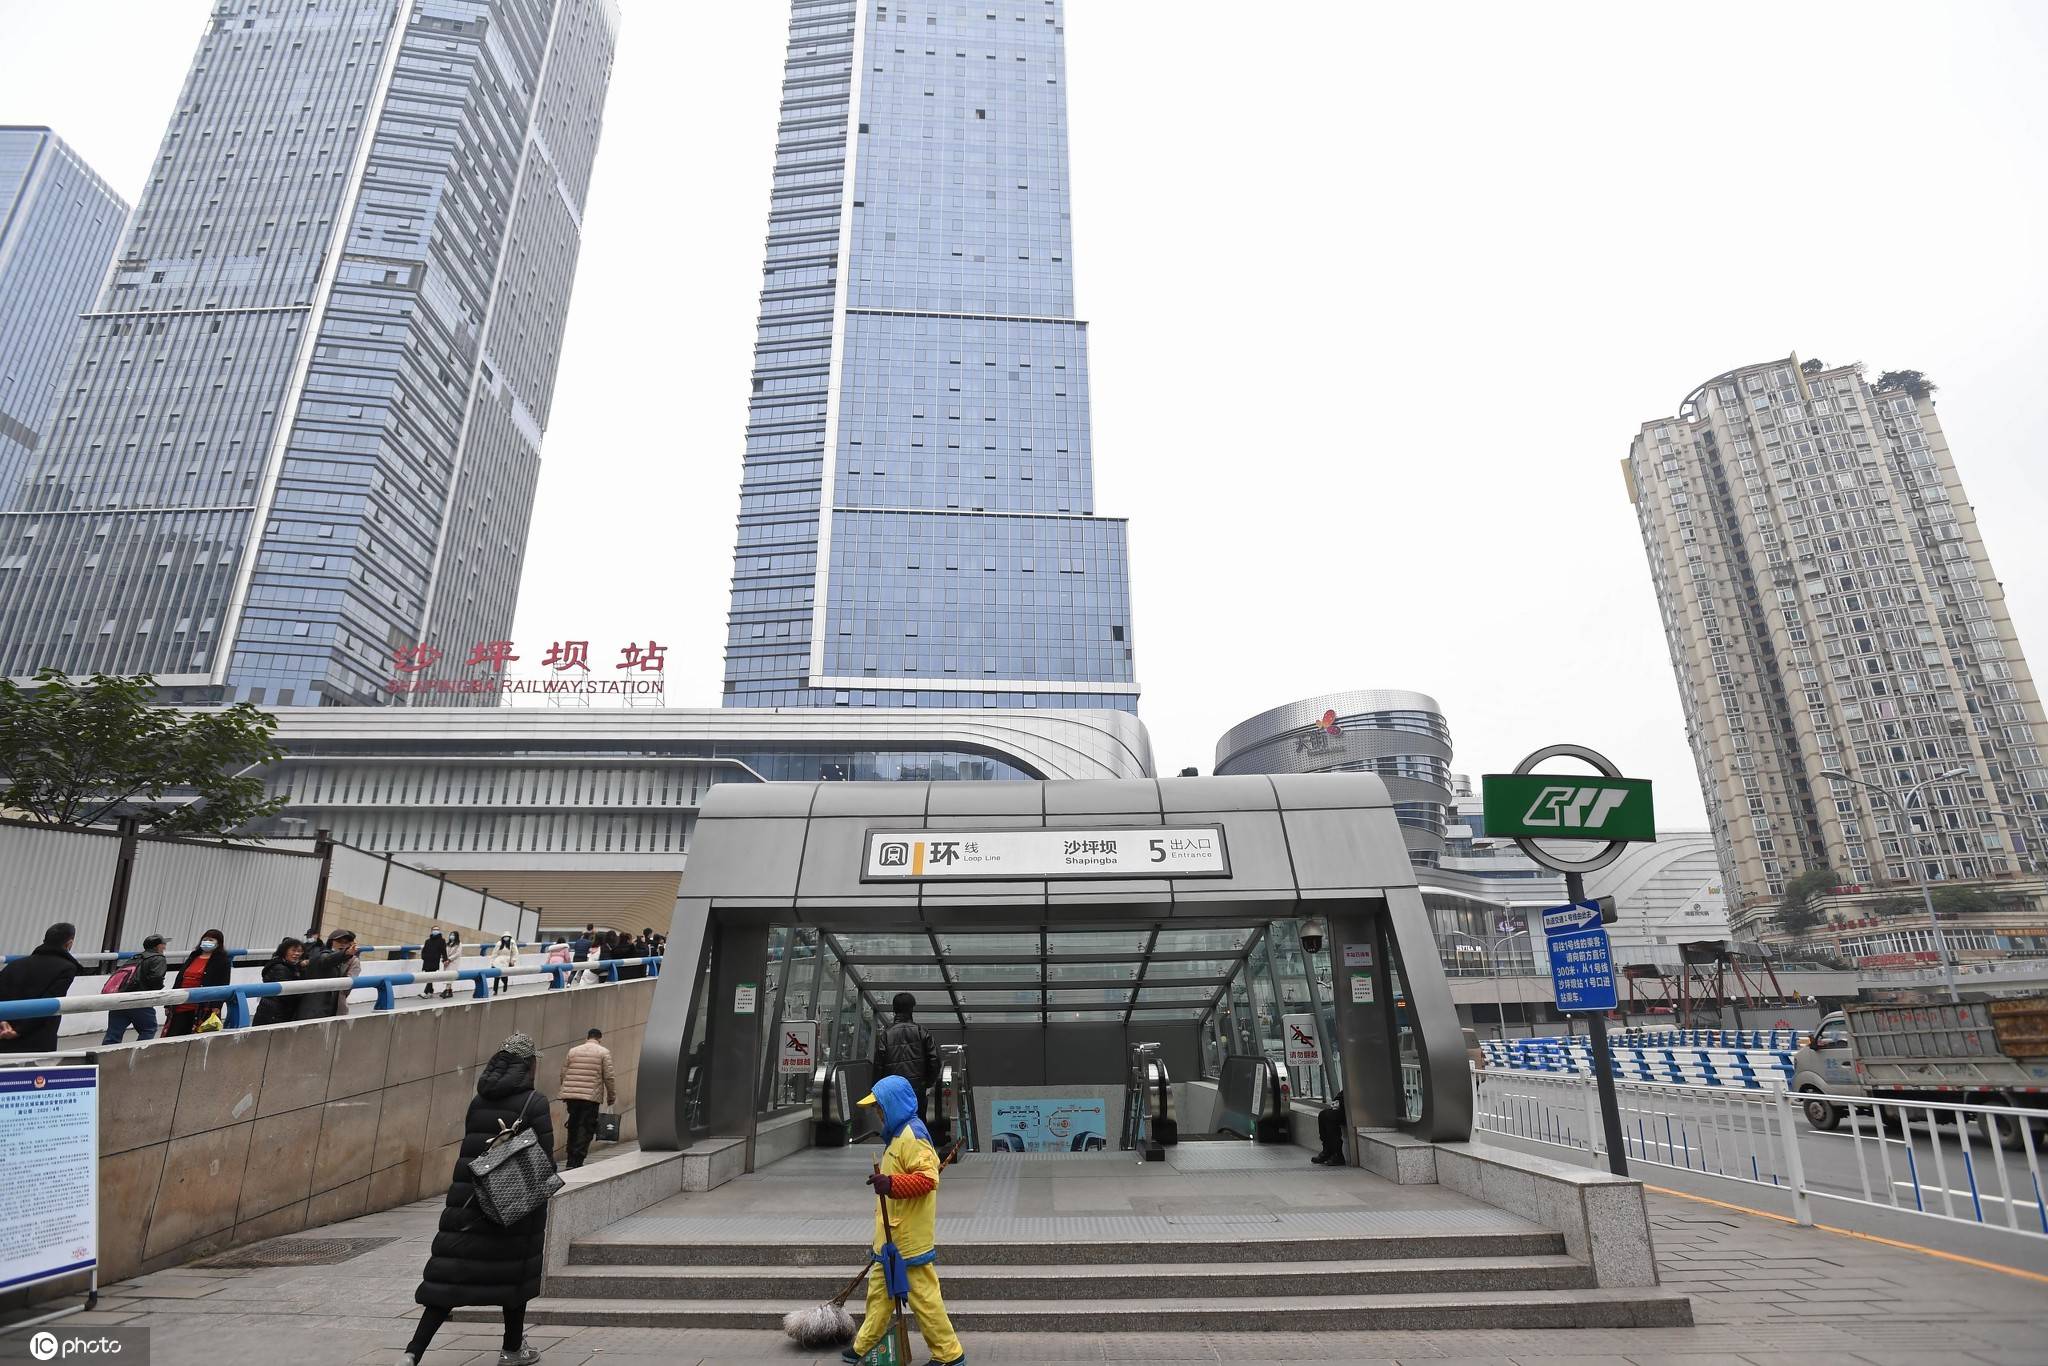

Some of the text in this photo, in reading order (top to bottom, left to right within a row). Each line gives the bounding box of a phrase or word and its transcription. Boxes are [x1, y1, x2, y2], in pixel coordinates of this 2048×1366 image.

[394, 640, 668, 673] 沙坪坝站
[386, 679, 665, 694] SHAPINGBA RAILWAY STATION
[929, 841, 979, 866] 环 线
[1064, 839, 1118, 855] 沙坪坝
[1149, 838, 1211, 863] 5 出入口
[1065, 856, 1118, 866] Shapingba
[1171, 851, 1212, 859] Entrance
[1566, 949, 1606, 963] 请向前方直行
[1558, 977, 1611, 990] 沙坪坝站1号口进
[783, 1058, 810, 1066] 请勿翻越
[1289, 1051, 1318, 1059] 请勿翻越
